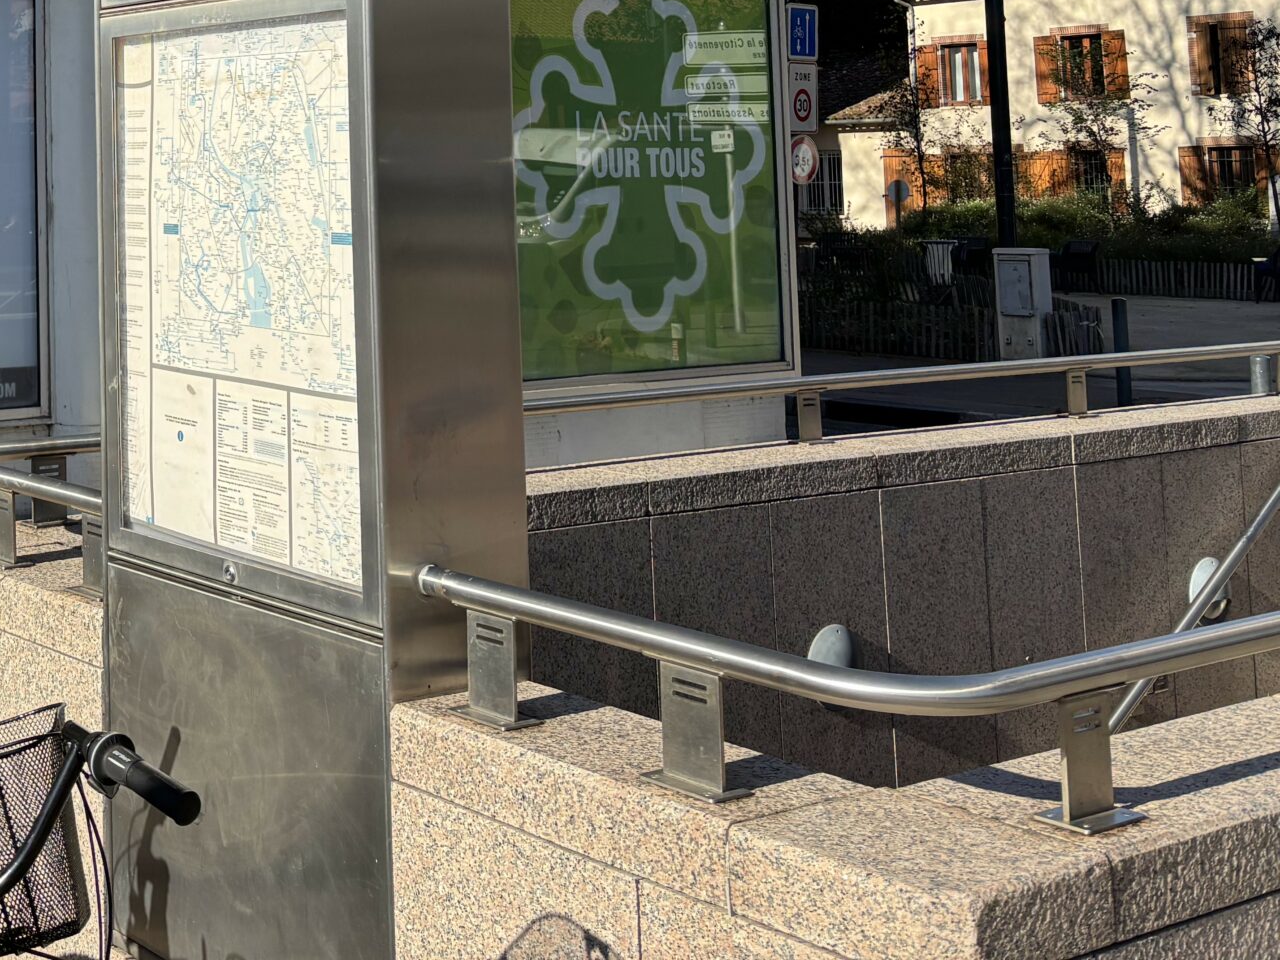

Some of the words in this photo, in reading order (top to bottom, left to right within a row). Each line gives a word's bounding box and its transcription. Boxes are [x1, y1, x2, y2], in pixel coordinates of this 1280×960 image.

[794, 72, 811, 82] ZONE
[797, 99, 808, 113] 30
[575, 110, 611, 142] LA
[576, 147, 640, 179] POUR
[646, 147, 705, 179] TOUS
